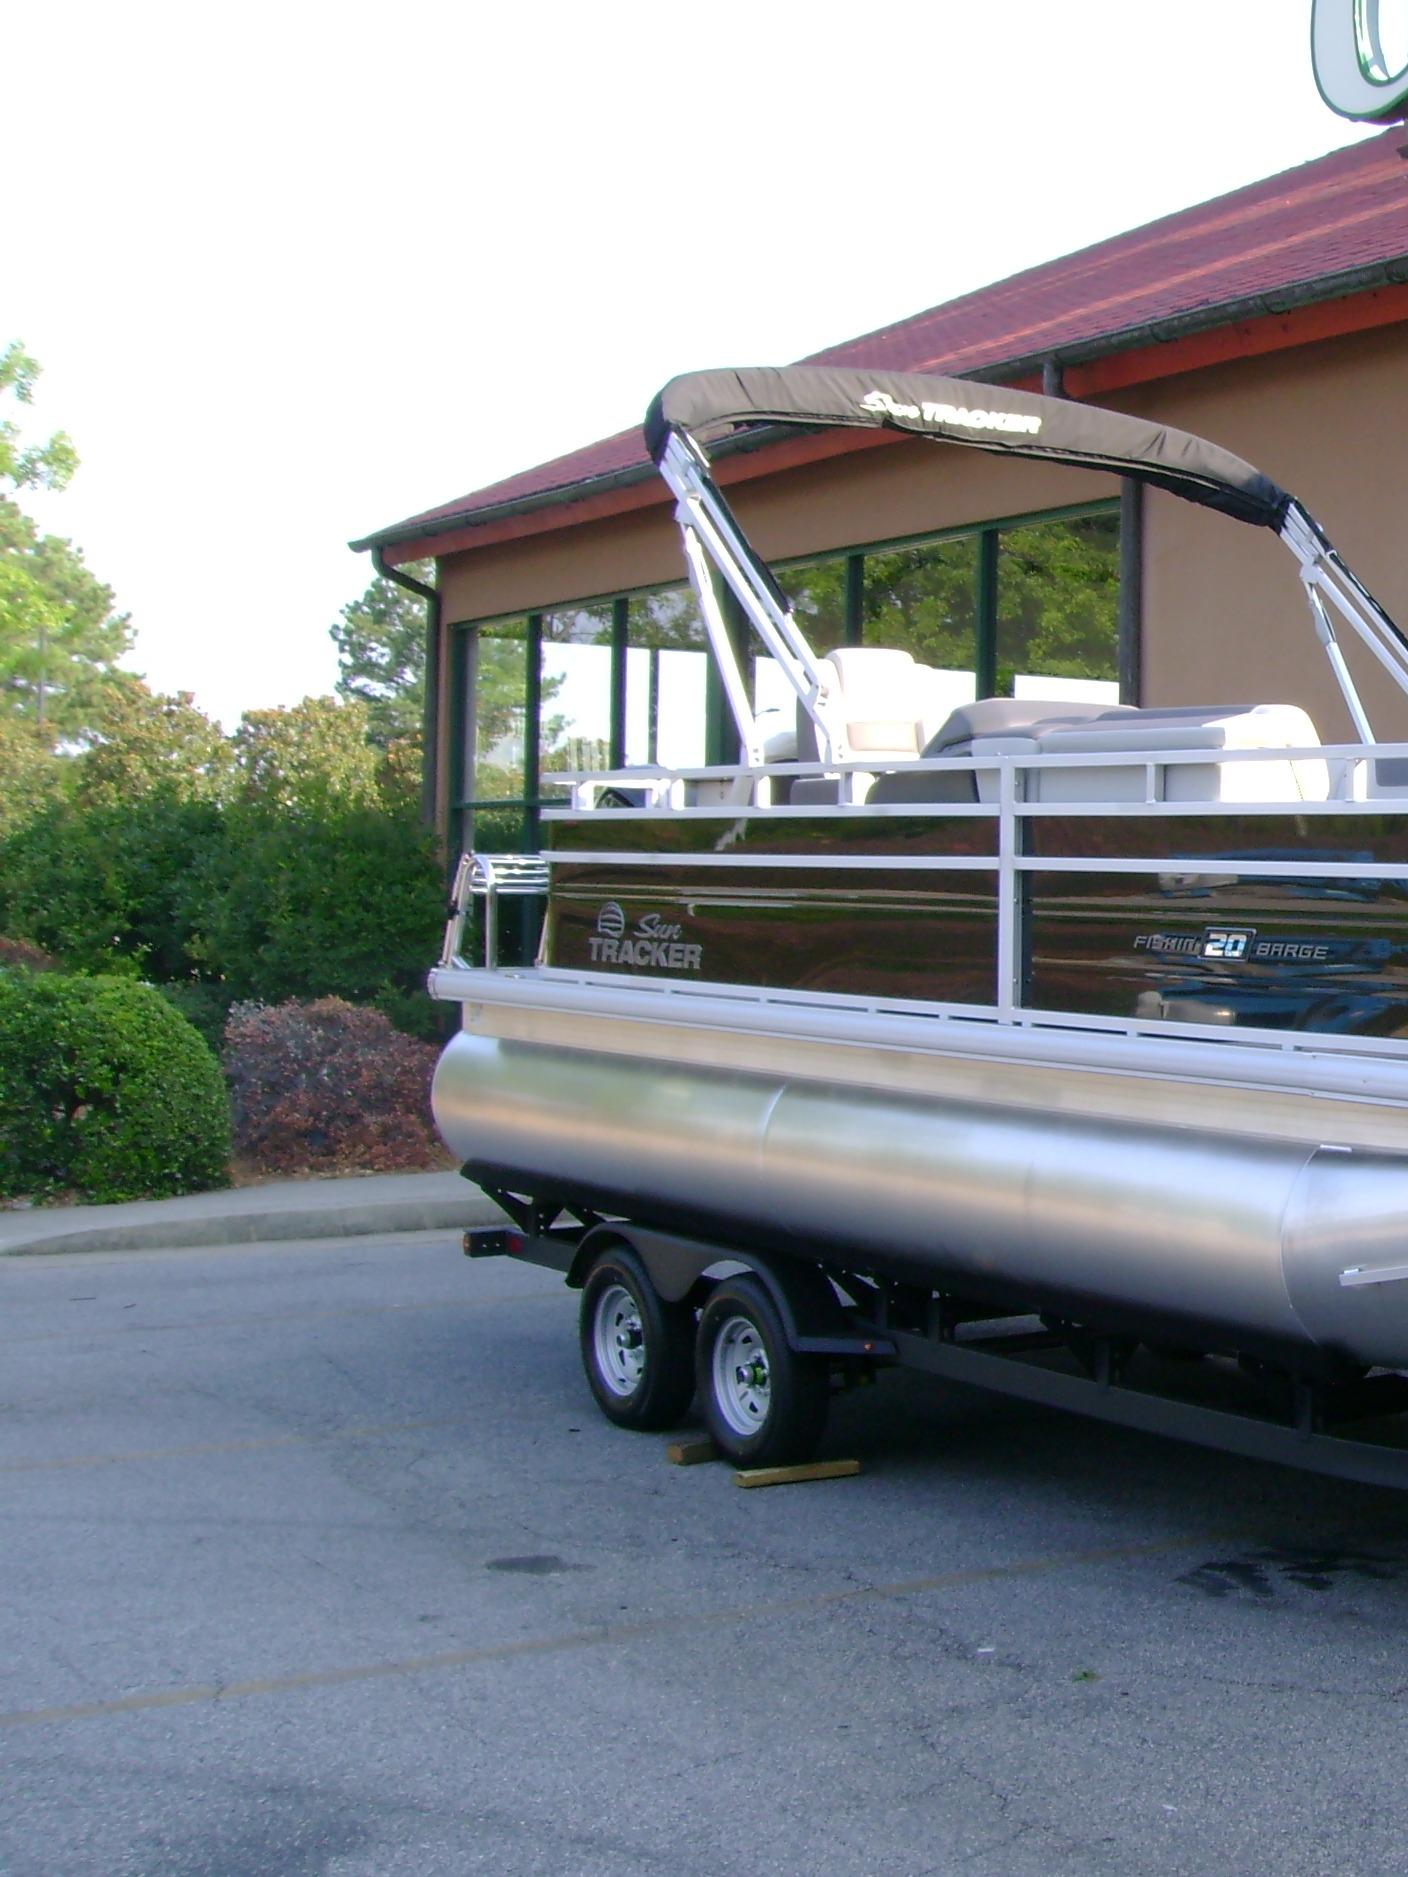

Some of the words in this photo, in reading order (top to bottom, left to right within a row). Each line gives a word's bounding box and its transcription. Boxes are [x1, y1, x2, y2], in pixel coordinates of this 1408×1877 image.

[921, 402, 1042, 434] TRACKER
[633, 913, 682, 940] Sun
[588, 937, 703, 970] TRACKER
[1204, 933, 1248, 957] 20
[1256, 942, 1329, 960] BARGE
